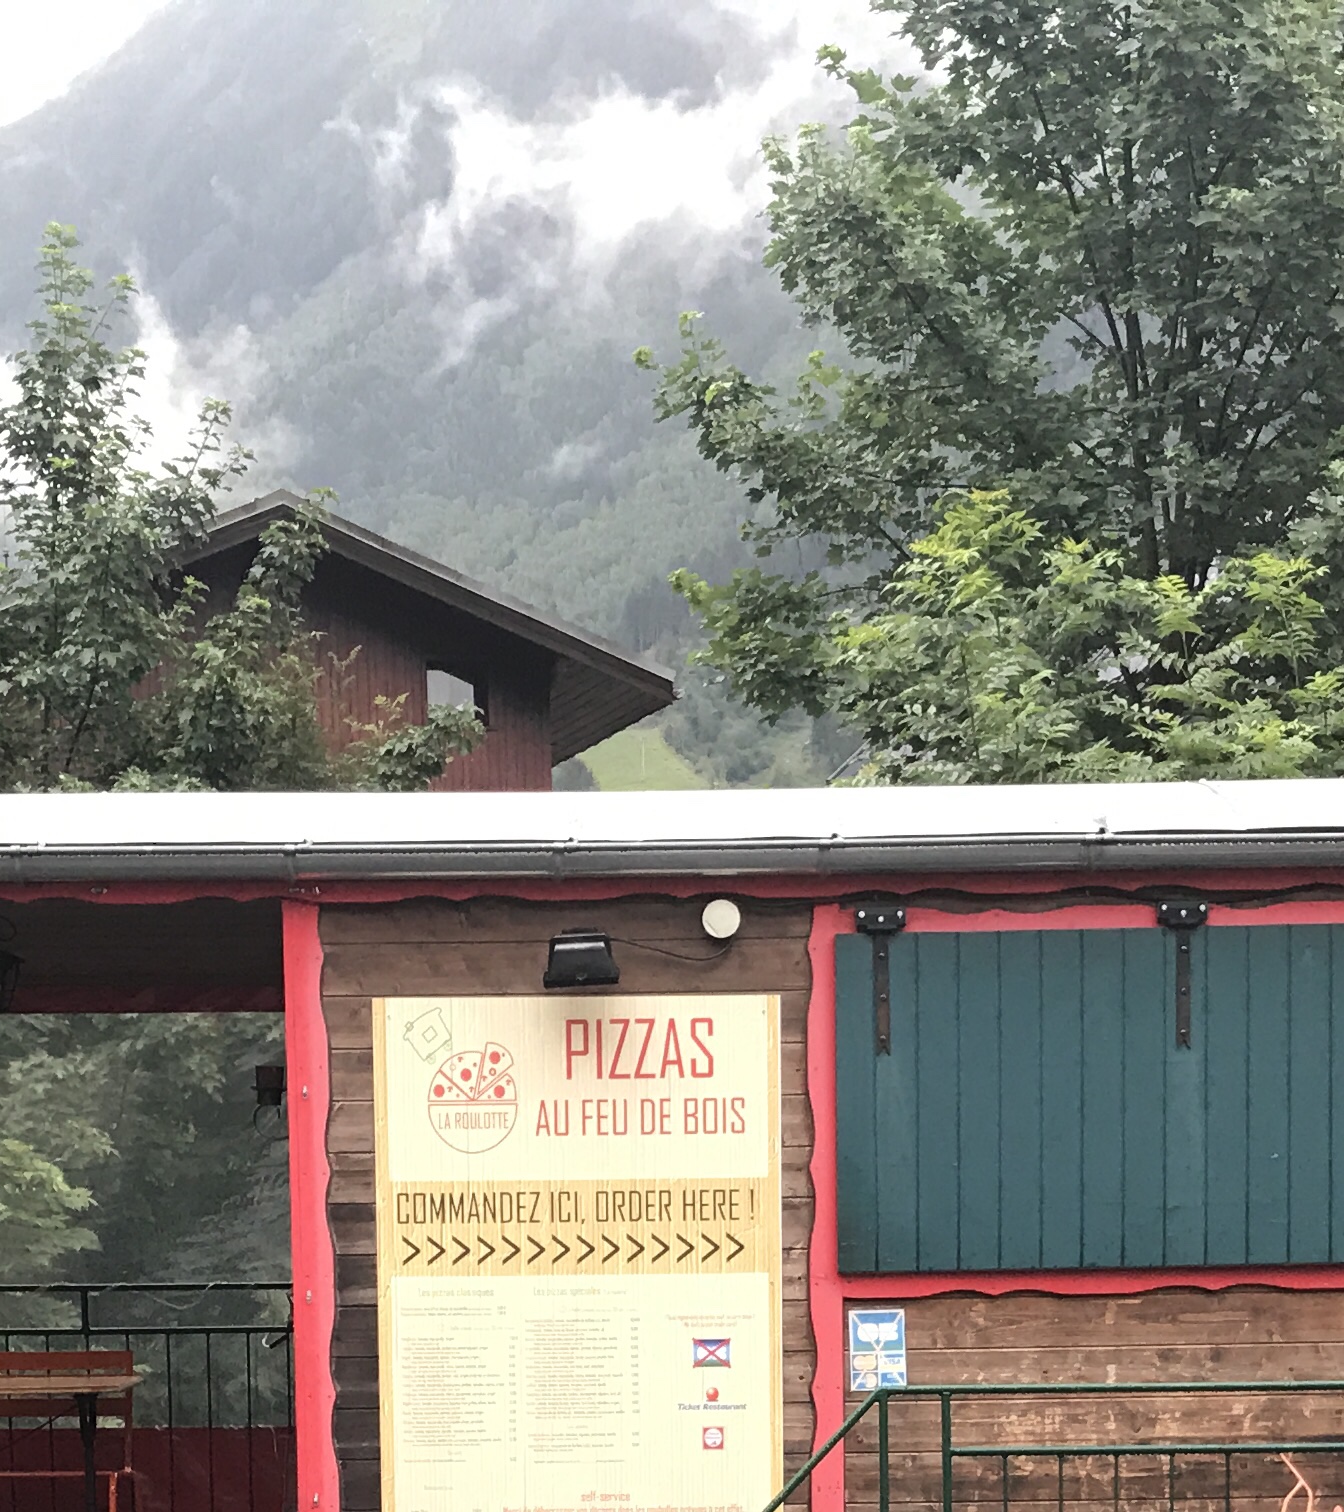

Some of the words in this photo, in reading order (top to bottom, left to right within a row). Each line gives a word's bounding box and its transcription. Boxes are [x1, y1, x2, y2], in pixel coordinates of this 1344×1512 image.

[565, 1017, 714, 1080] PIZZAS
[438, 1111, 452, 1130] LA
[454, 1110, 510, 1130] ROULOTTE
[536, 1099, 569, 1136] AU
[581, 1098, 629, 1136] FEU
[640, 1098, 671, 1135] DE
[683, 1097, 746, 1134] BOIS
[397, 1191, 541, 1224] COMMANDEZ
[550, 1190, 586, 1225] ICI,
[595, 1190, 671, 1223] ORDER
[682, 1189, 740, 1221] HERE
[677, 1403, 701, 1411] Ticket
